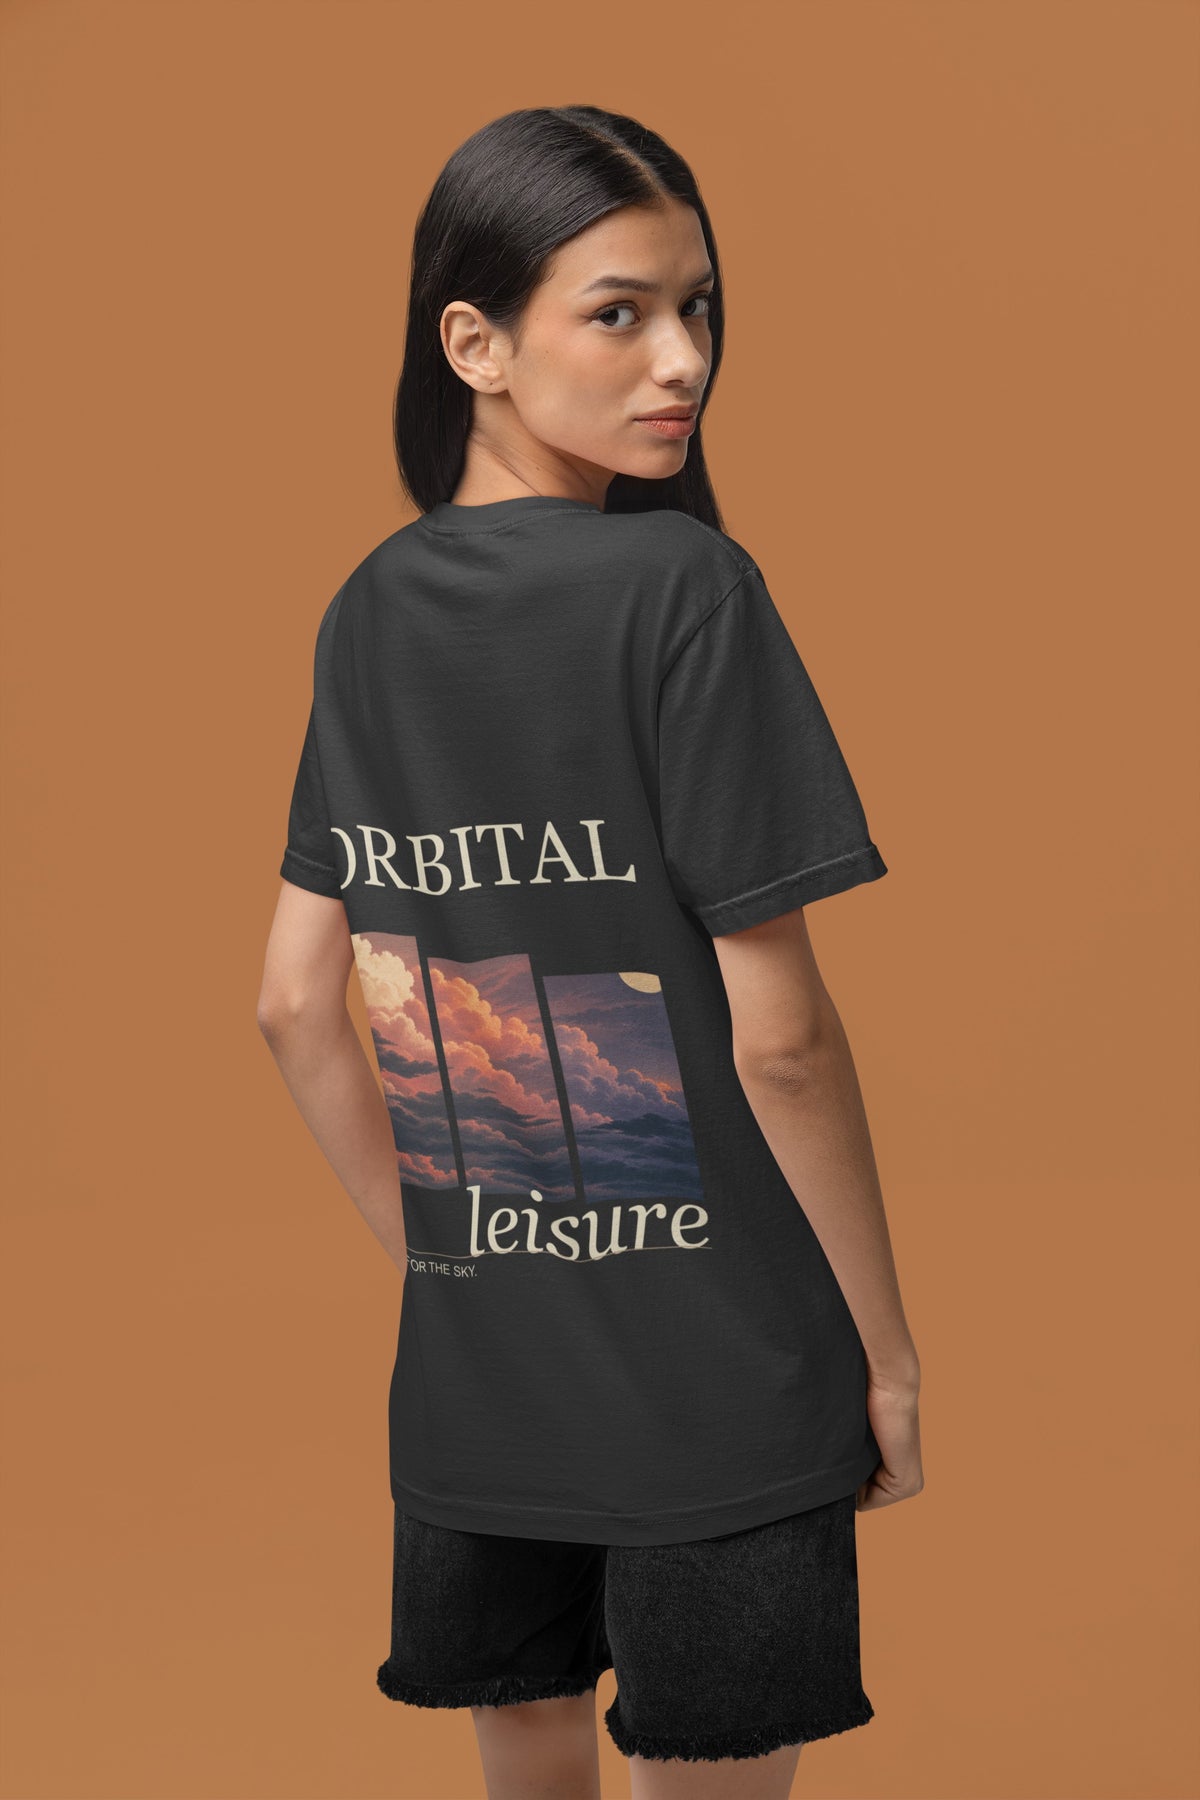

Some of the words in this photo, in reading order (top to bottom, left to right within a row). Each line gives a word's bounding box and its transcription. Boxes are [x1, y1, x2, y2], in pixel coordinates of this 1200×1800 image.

[466, 1185, 709, 1261] leisure
[428, 1261, 451, 1276] THE
[453, 1264, 478, 1278] SKY.
